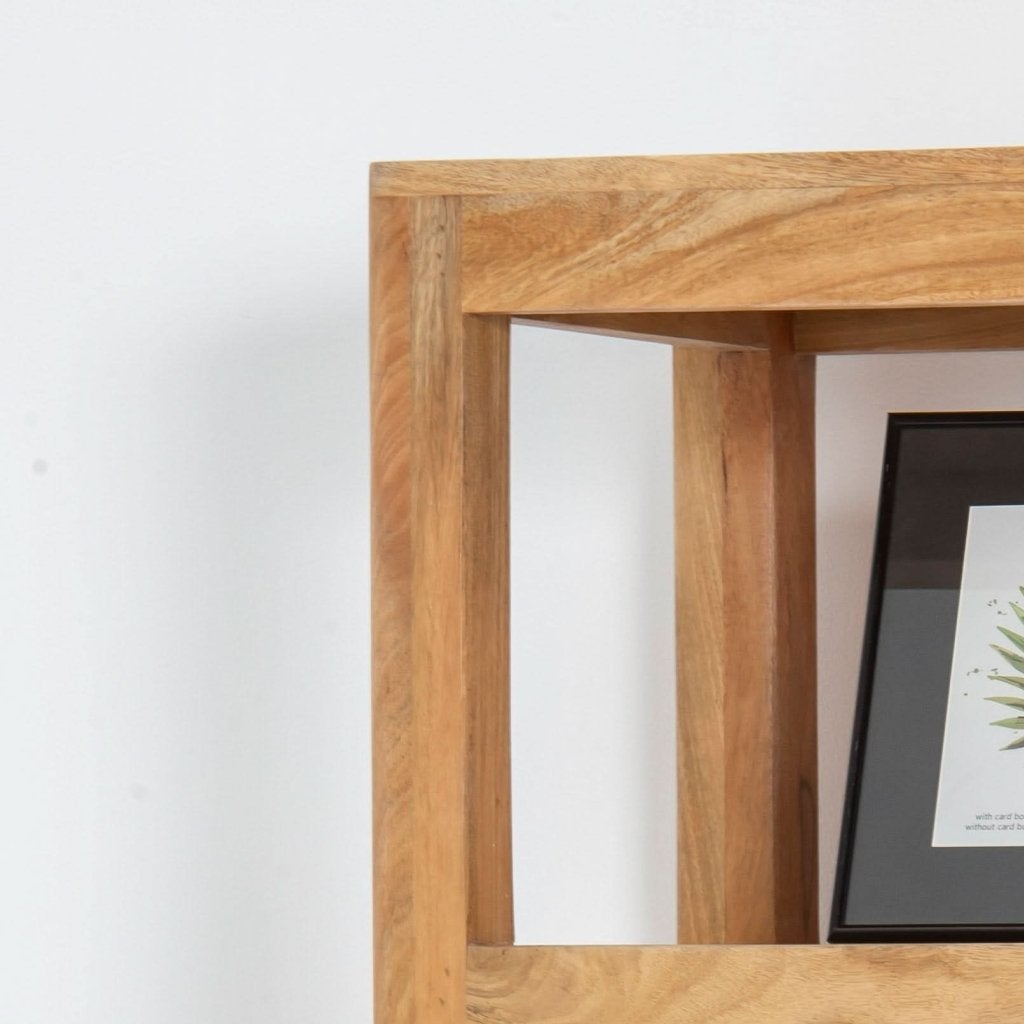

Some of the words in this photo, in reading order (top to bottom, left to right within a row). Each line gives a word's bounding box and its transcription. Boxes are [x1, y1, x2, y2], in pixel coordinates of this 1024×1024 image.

[975, 812, 992, 820] with
[994, 812, 1012, 820] card
[965, 823, 995, 831] without
[997, 823, 1015, 831] card
